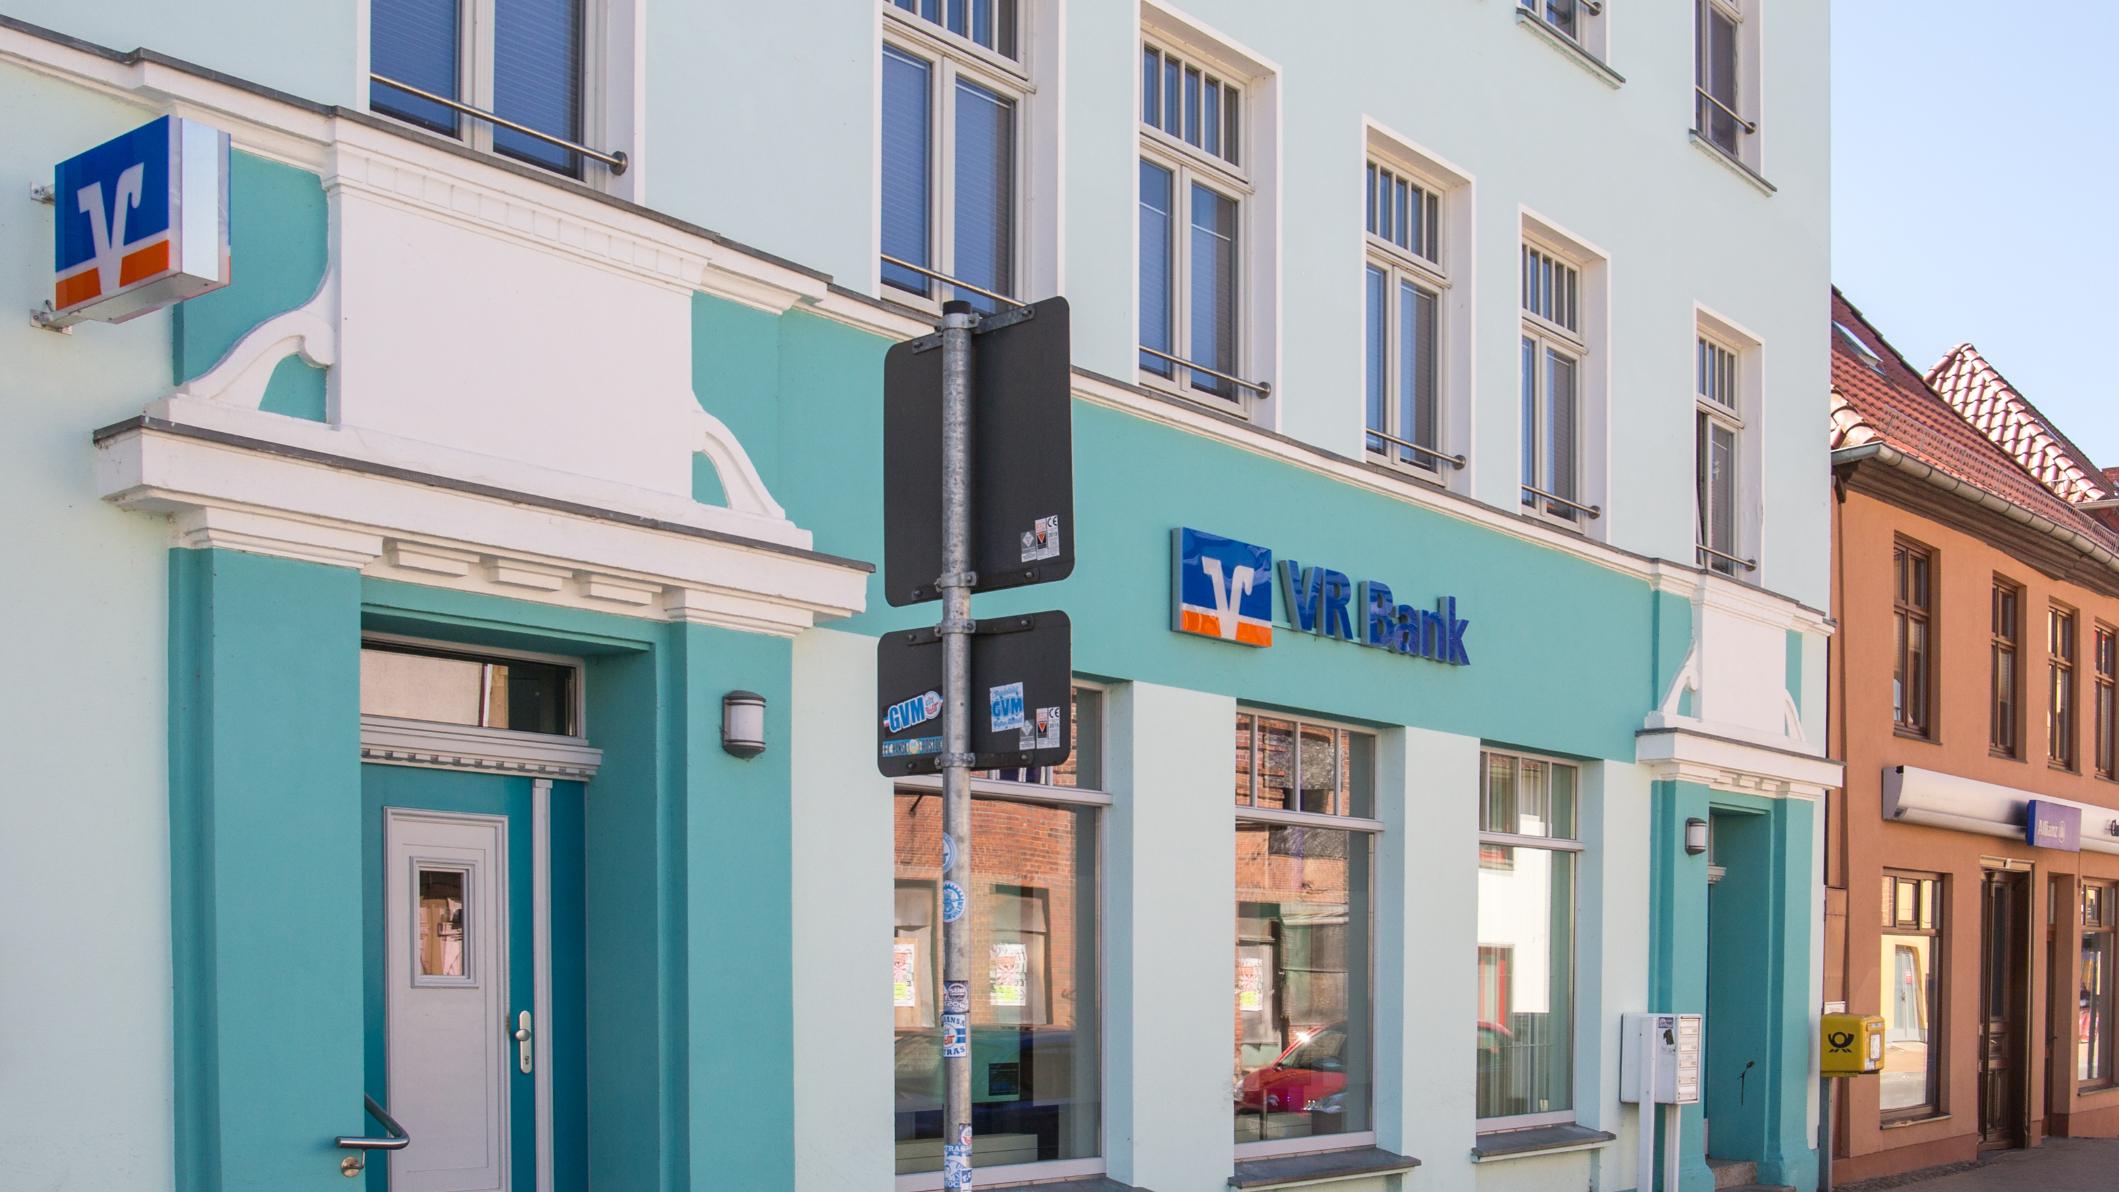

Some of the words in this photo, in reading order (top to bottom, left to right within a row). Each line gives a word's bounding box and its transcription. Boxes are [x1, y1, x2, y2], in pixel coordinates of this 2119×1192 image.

[1278, 559, 1353, 640] VR
[1360, 580, 1470, 666] Bank
[889, 696, 925, 731] GVM
[992, 697, 1023, 717] GVM
